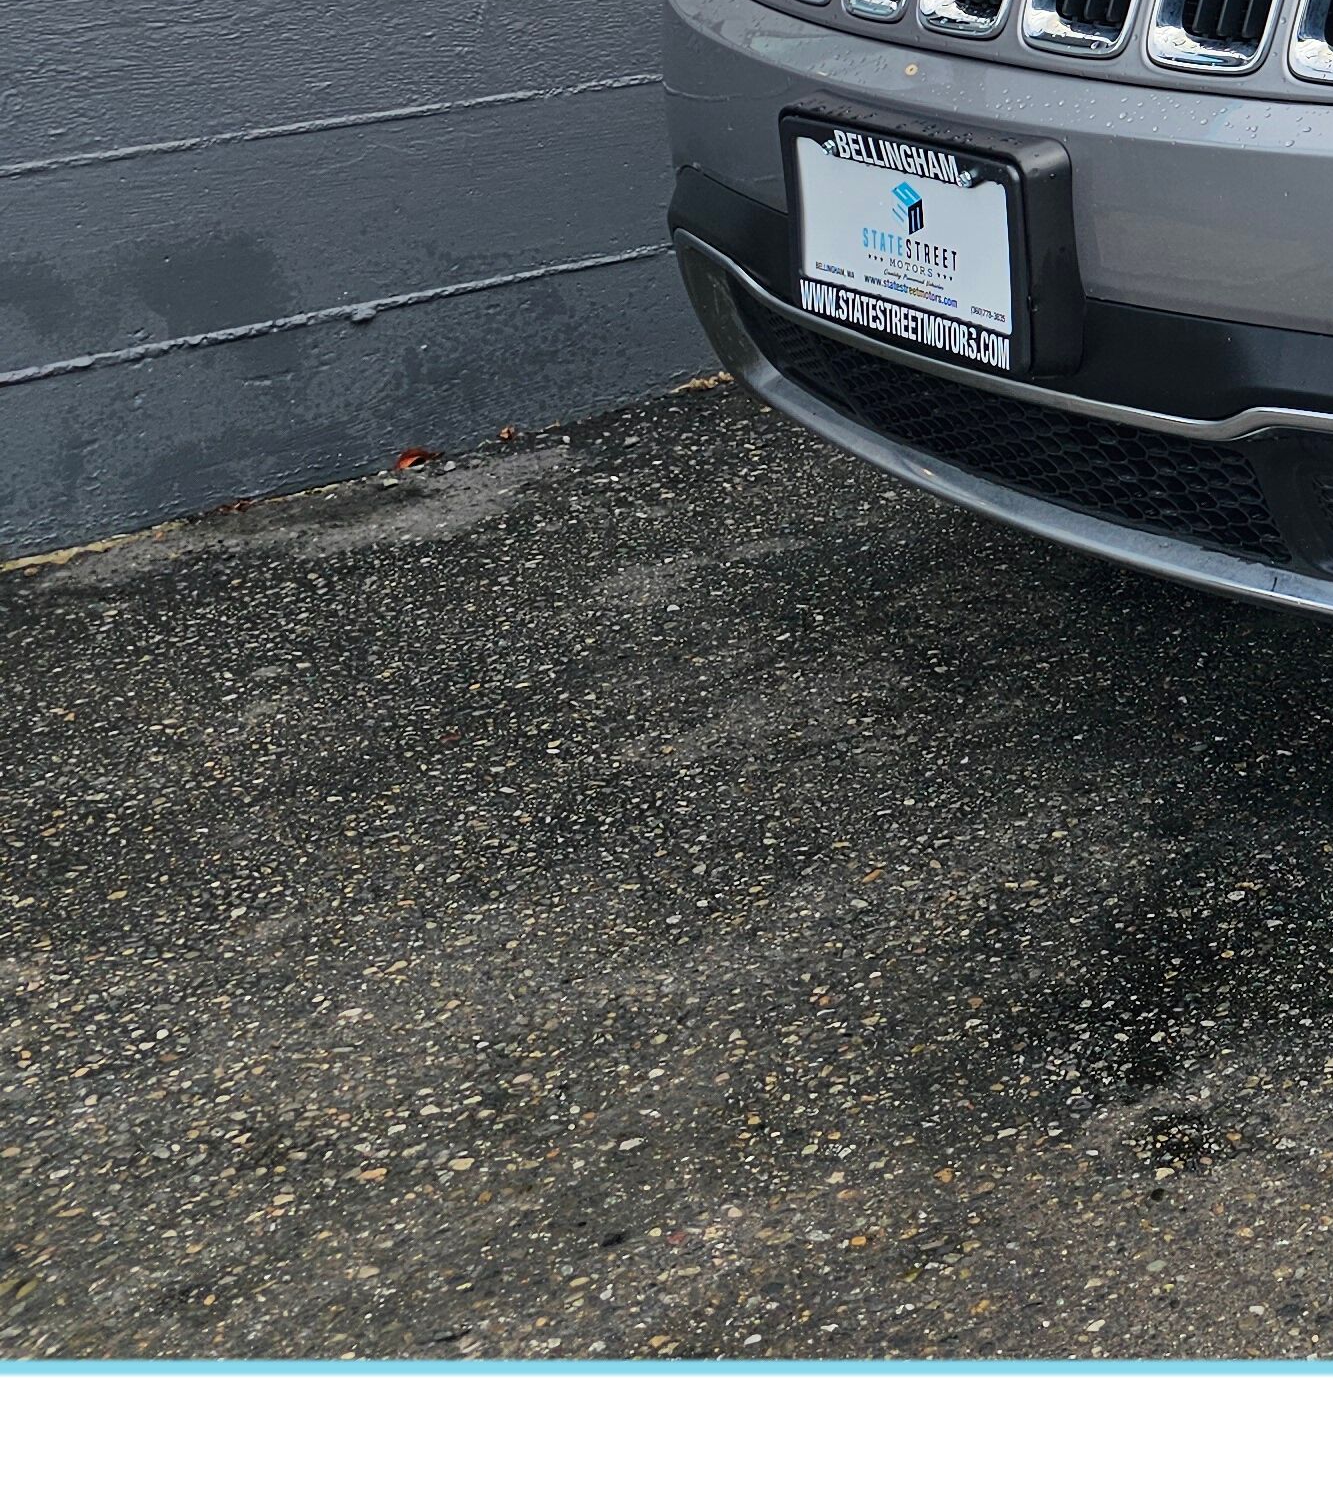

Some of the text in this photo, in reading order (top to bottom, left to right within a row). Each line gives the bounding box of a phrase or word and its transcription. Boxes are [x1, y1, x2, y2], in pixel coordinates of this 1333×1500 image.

[833, 130, 960, 183] BELLINGHAM
[889, 257, 933, 278] MOTORS
[800, 279, 1010, 370] WWW.STATESTREETMOTORS.COM
